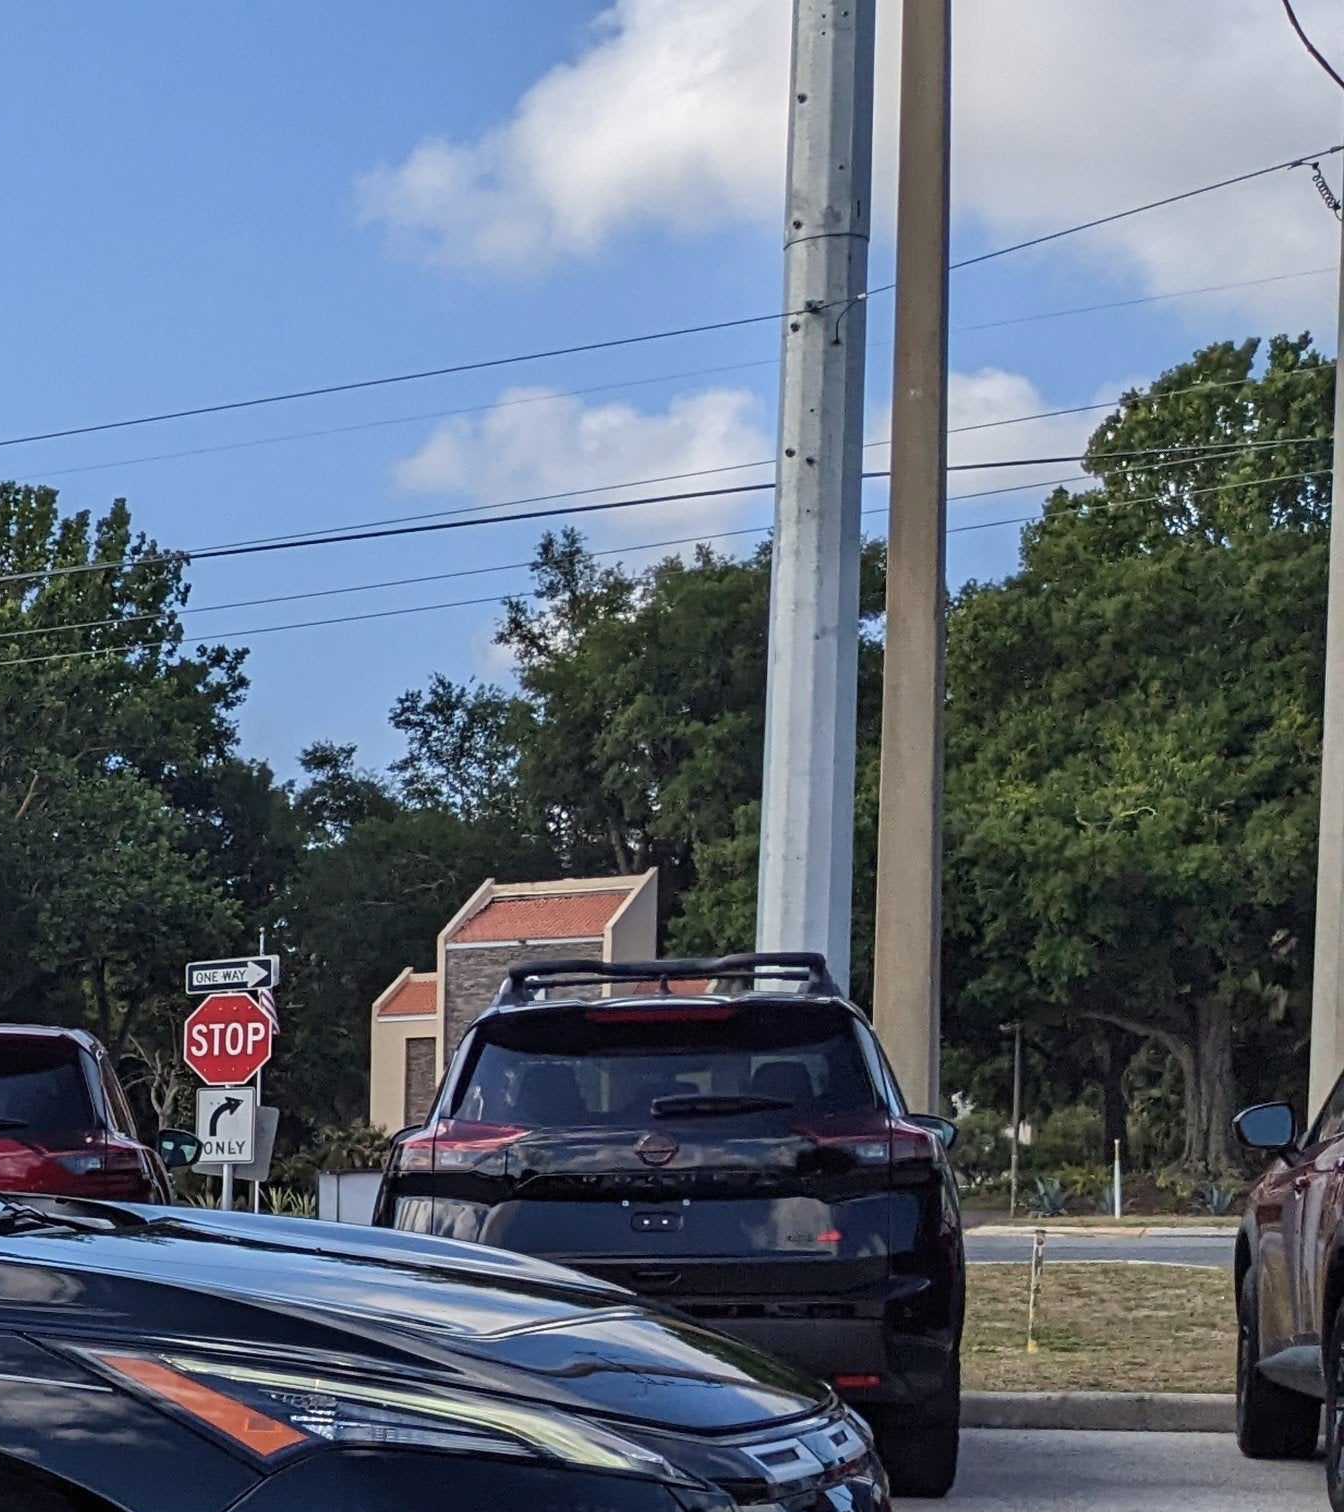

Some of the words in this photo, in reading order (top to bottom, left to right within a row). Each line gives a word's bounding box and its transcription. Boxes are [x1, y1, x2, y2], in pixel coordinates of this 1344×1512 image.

[196, 970, 219, 983] ONE
[223, 969, 246, 982] WAY
[190, 1022, 266, 1058] STOP
[204, 1141, 246, 1156] ONLY
